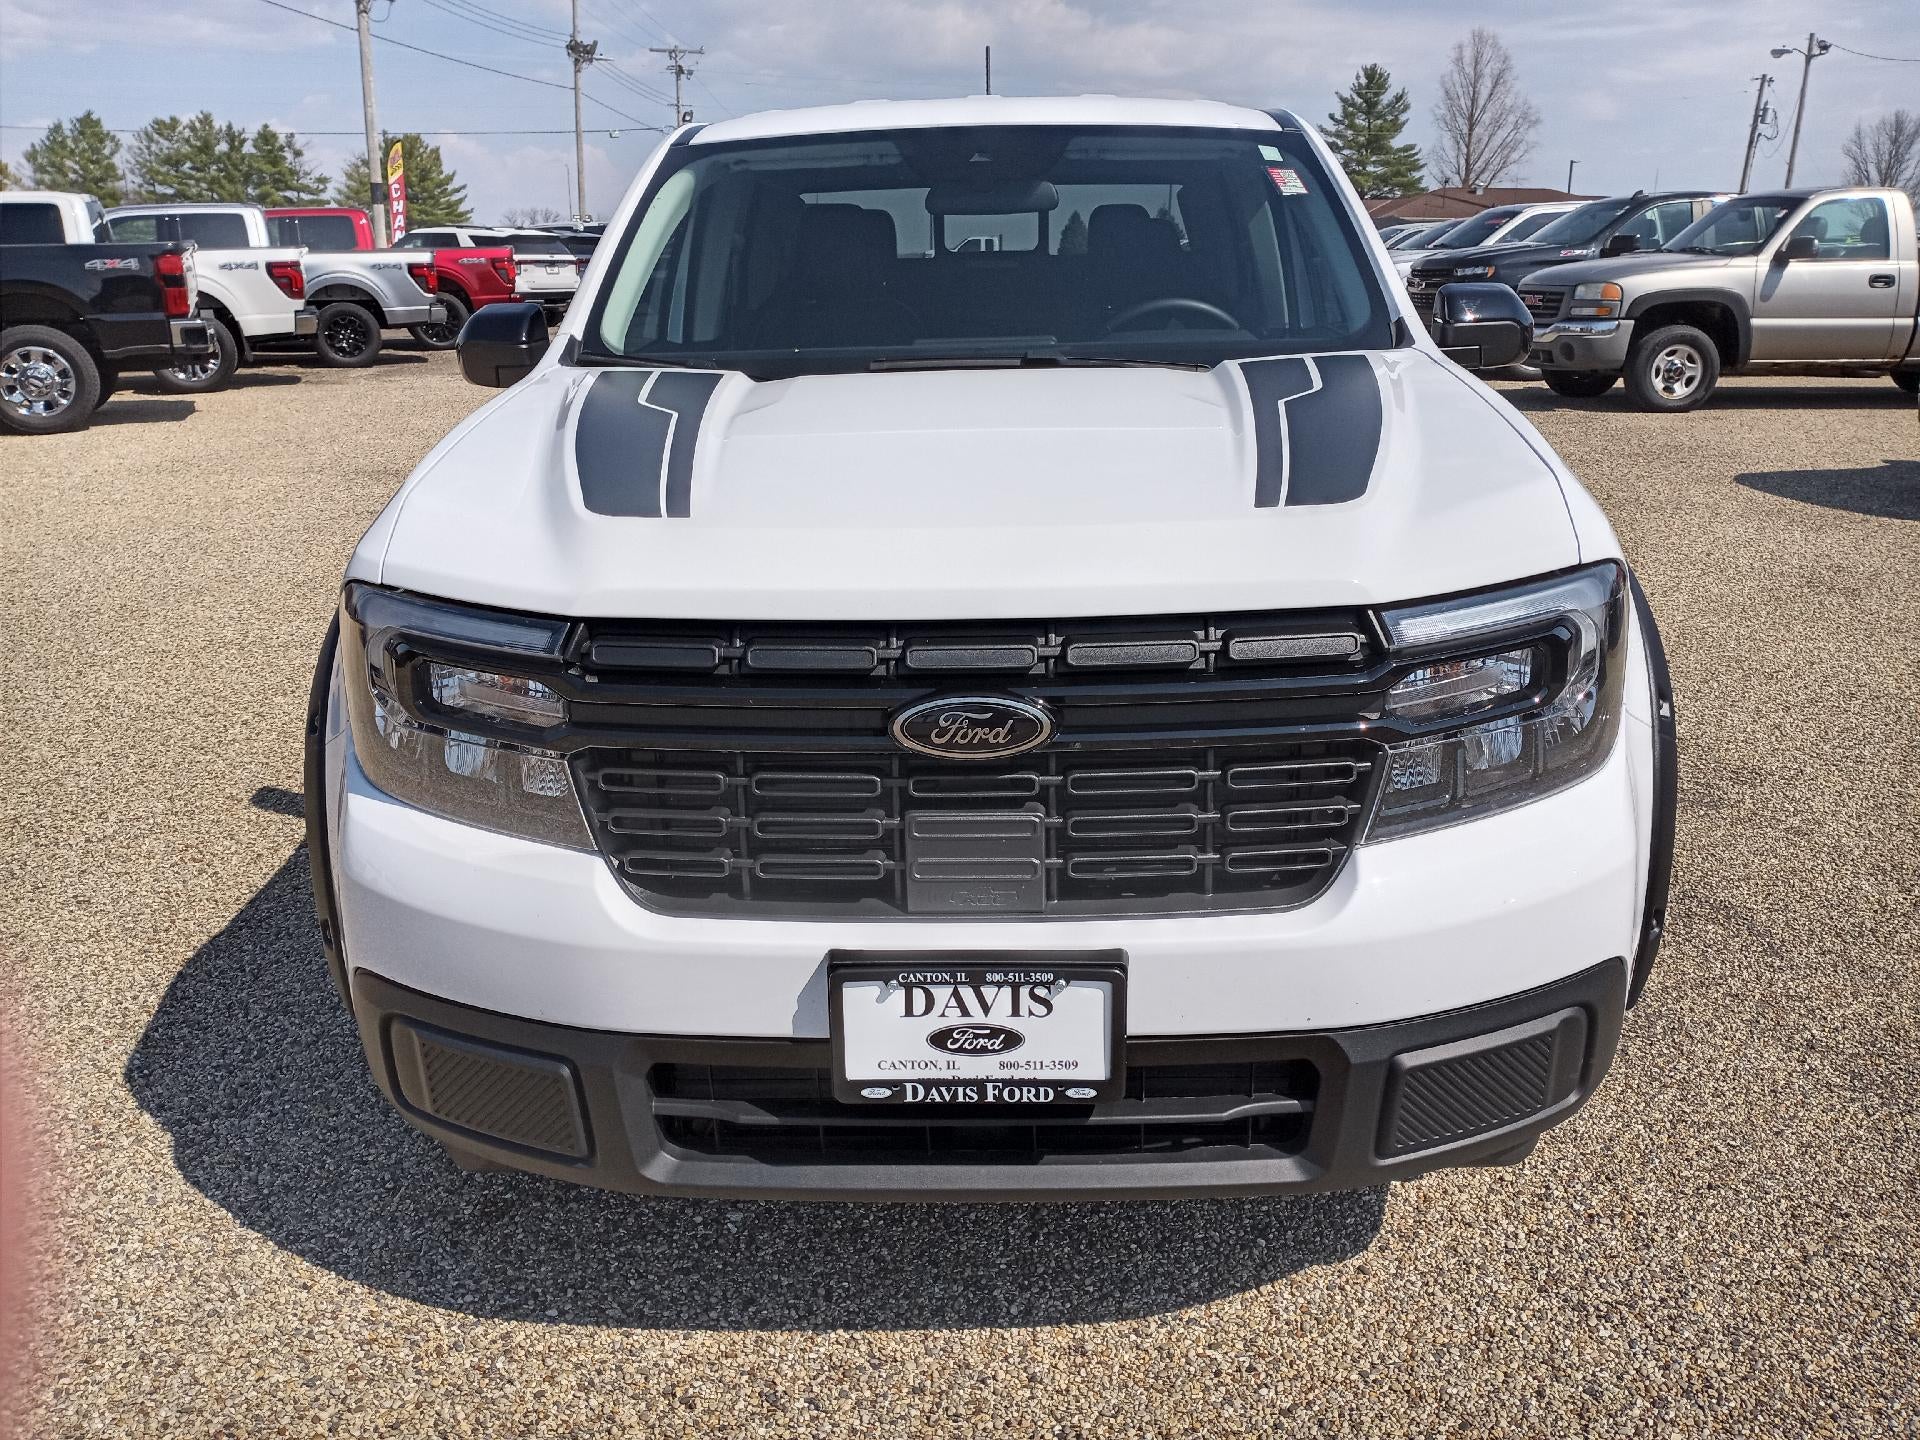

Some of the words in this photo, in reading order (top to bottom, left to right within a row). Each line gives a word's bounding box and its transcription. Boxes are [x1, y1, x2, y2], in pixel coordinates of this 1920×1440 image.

[930, 711, 1014, 744] Ford
[898, 972, 954, 983] CANTON,
[956, 973, 970, 983] IL
[985, 972, 1054, 983] 800-511-3509
[900, 984, 1055, 1018] DAVIS
[946, 1028, 1006, 1050] Ford
[877, 1059, 943, 1072] CANTON,
[945, 1059, 961, 1071] IL
[998, 1059, 1079, 1071] 800-511-3509
[903, 1083, 978, 1103] DAVIS
[984, 1082, 1055, 1103] FORD
